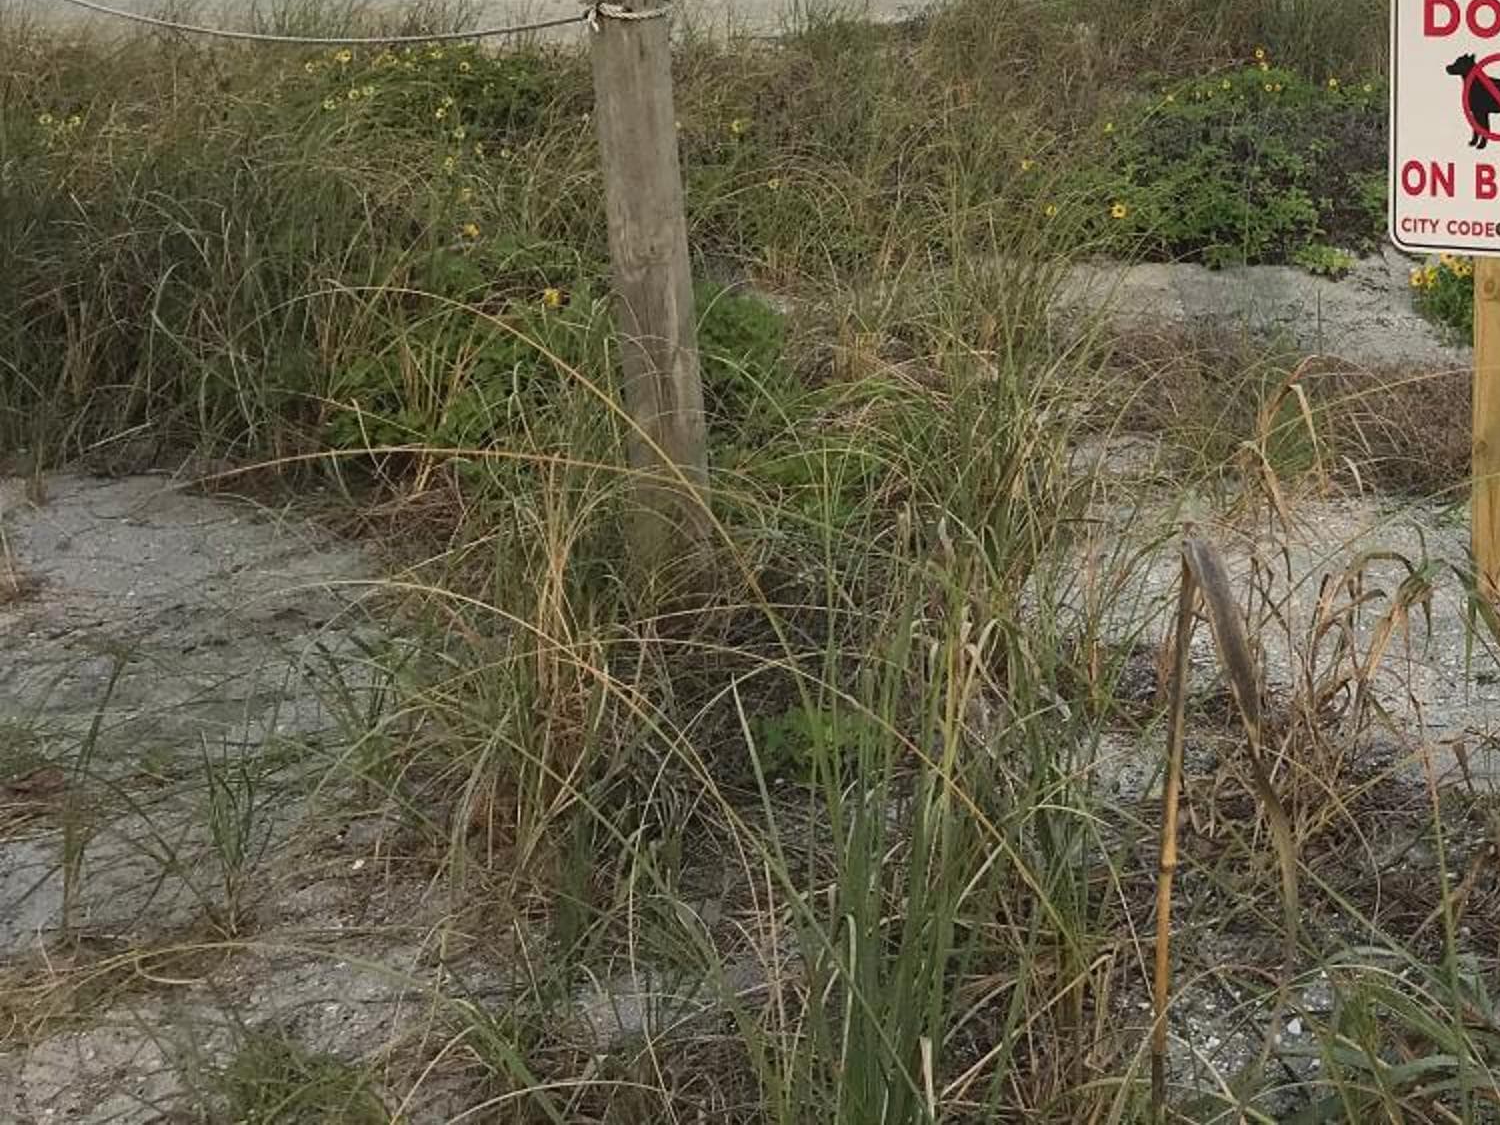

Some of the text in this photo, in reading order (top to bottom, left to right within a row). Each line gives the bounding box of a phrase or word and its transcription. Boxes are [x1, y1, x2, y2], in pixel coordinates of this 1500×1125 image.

[1401, 160, 1455, 198] ON
[1401, 218, 1440, 234] CITY
[1447, 220, 1497, 237] CODE
